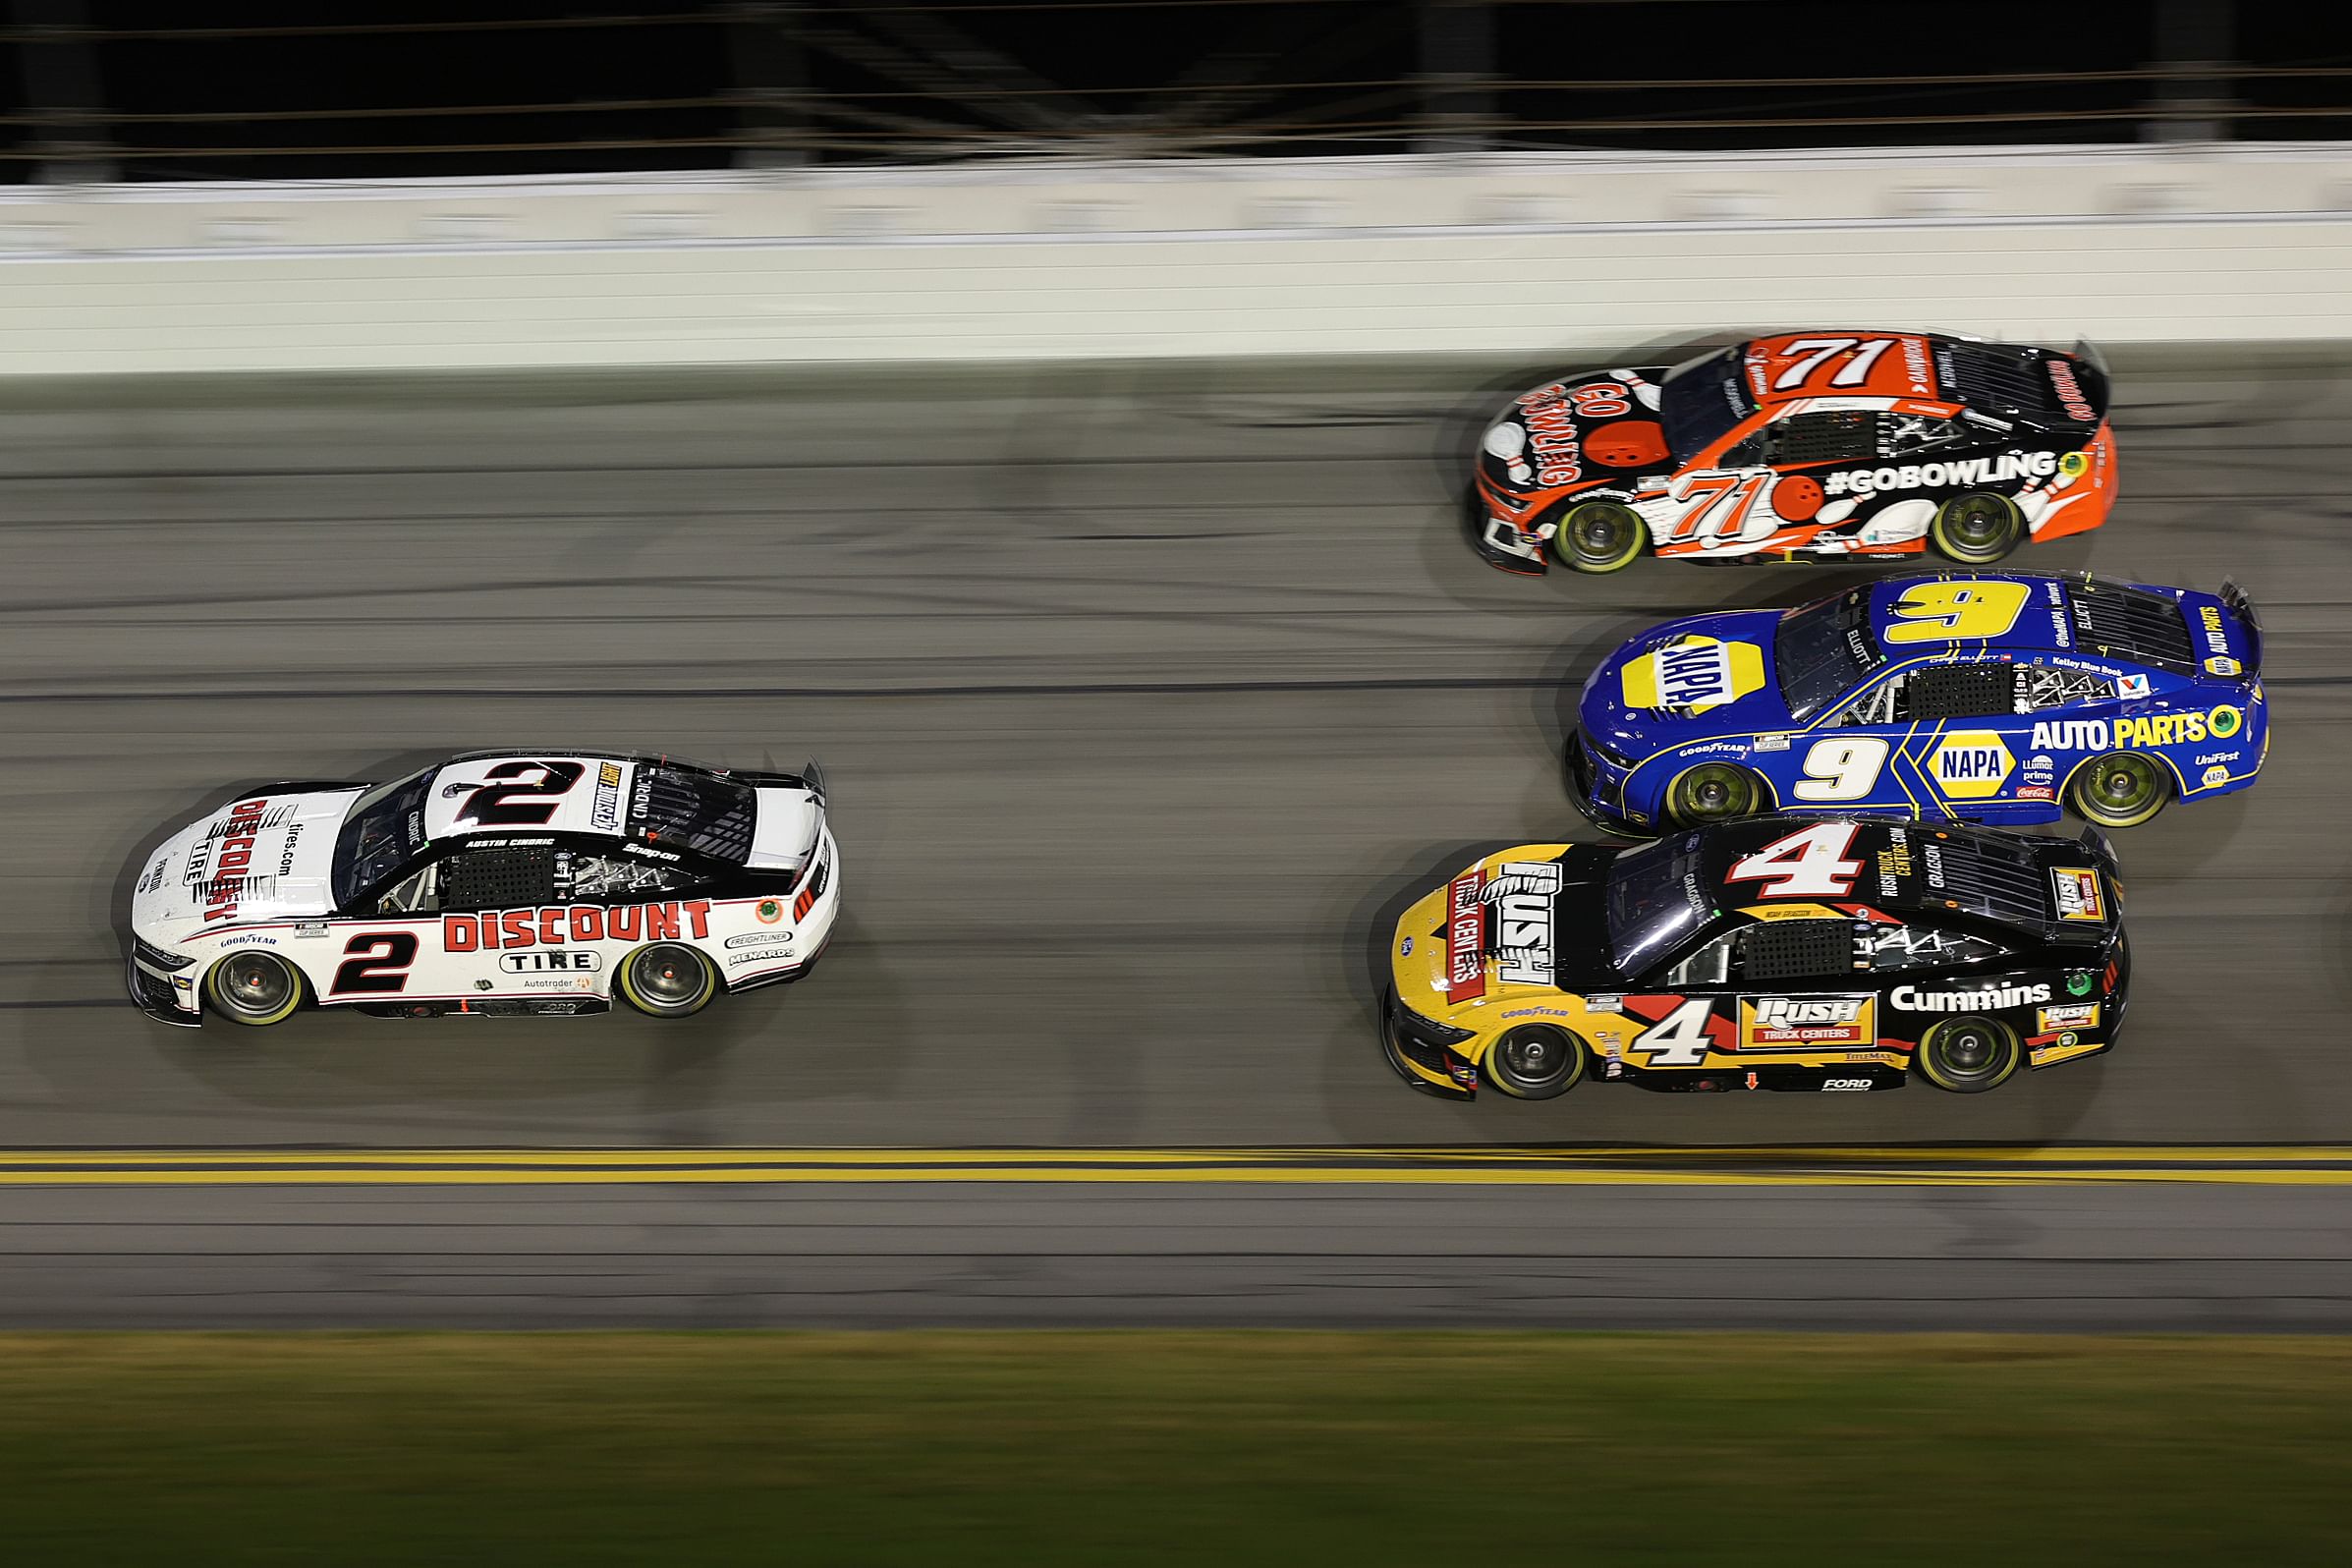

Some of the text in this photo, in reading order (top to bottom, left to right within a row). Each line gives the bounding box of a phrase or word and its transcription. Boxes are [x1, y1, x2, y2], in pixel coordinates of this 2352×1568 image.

[1772, 337, 1898, 392] 71
[1572, 382, 1631, 418] GO
[1823, 451, 2056, 494] #GOBOWLING
[1672, 470, 1776, 539] 71
[1883, 581, 2032, 644] 9
[2200, 606, 2229, 653] AUTO PARTS
[1847, 629, 1869, 664] ELLIOTT
[2052, 656, 2080, 669] Kelley
[2080, 661, 2100, 672] Blue
[2100, 665, 2123, 677] Book
[1662, 644, 1723, 708] NAPA
[1679, 743, 1746, 757] GOODYEAR
[2030, 712, 2207, 751] AUTO PARTS
[1793, 738, 1889, 801] 9
[1942, 749, 2002, 779] NAPA
[2024, 771, 2053, 781] prime
[2195, 751, 2240, 765] UniFirst
[453, 760, 587, 826] 2
[592, 762, 621, 829] KEYSTONE LIGHT
[409, 812, 420, 845] CINDRIC
[466, 839, 508, 848] AUSTIN
[186, 841, 209, 882] TIRE
[203, 800, 267, 923] DISCOUNT
[278, 823, 305, 876] tires.com
[622, 843, 682, 862] Snap-on
[1724, 821, 1867, 899] 4
[1926, 845, 1944, 888] GRAGSON
[1684, 873, 1707, 914] GRAGSON
[220, 934, 277, 948] GOODYEAR
[444, 901, 710, 952] DISCOUNT
[1454, 875, 1481, 983] TRUCK CENTERS
[329, 931, 420, 995] 2
[510, 953, 591, 972] TIRE
[729, 948, 794, 966] MENARDS
[1755, 998, 1863, 1030] RUSH
[1890, 981, 2052, 1013] Cummins
[1629, 997, 1716, 1066] 4
[1763, 1028, 1850, 1040] TRUCK CENTERS
[1823, 1080, 1873, 1089] FORD
